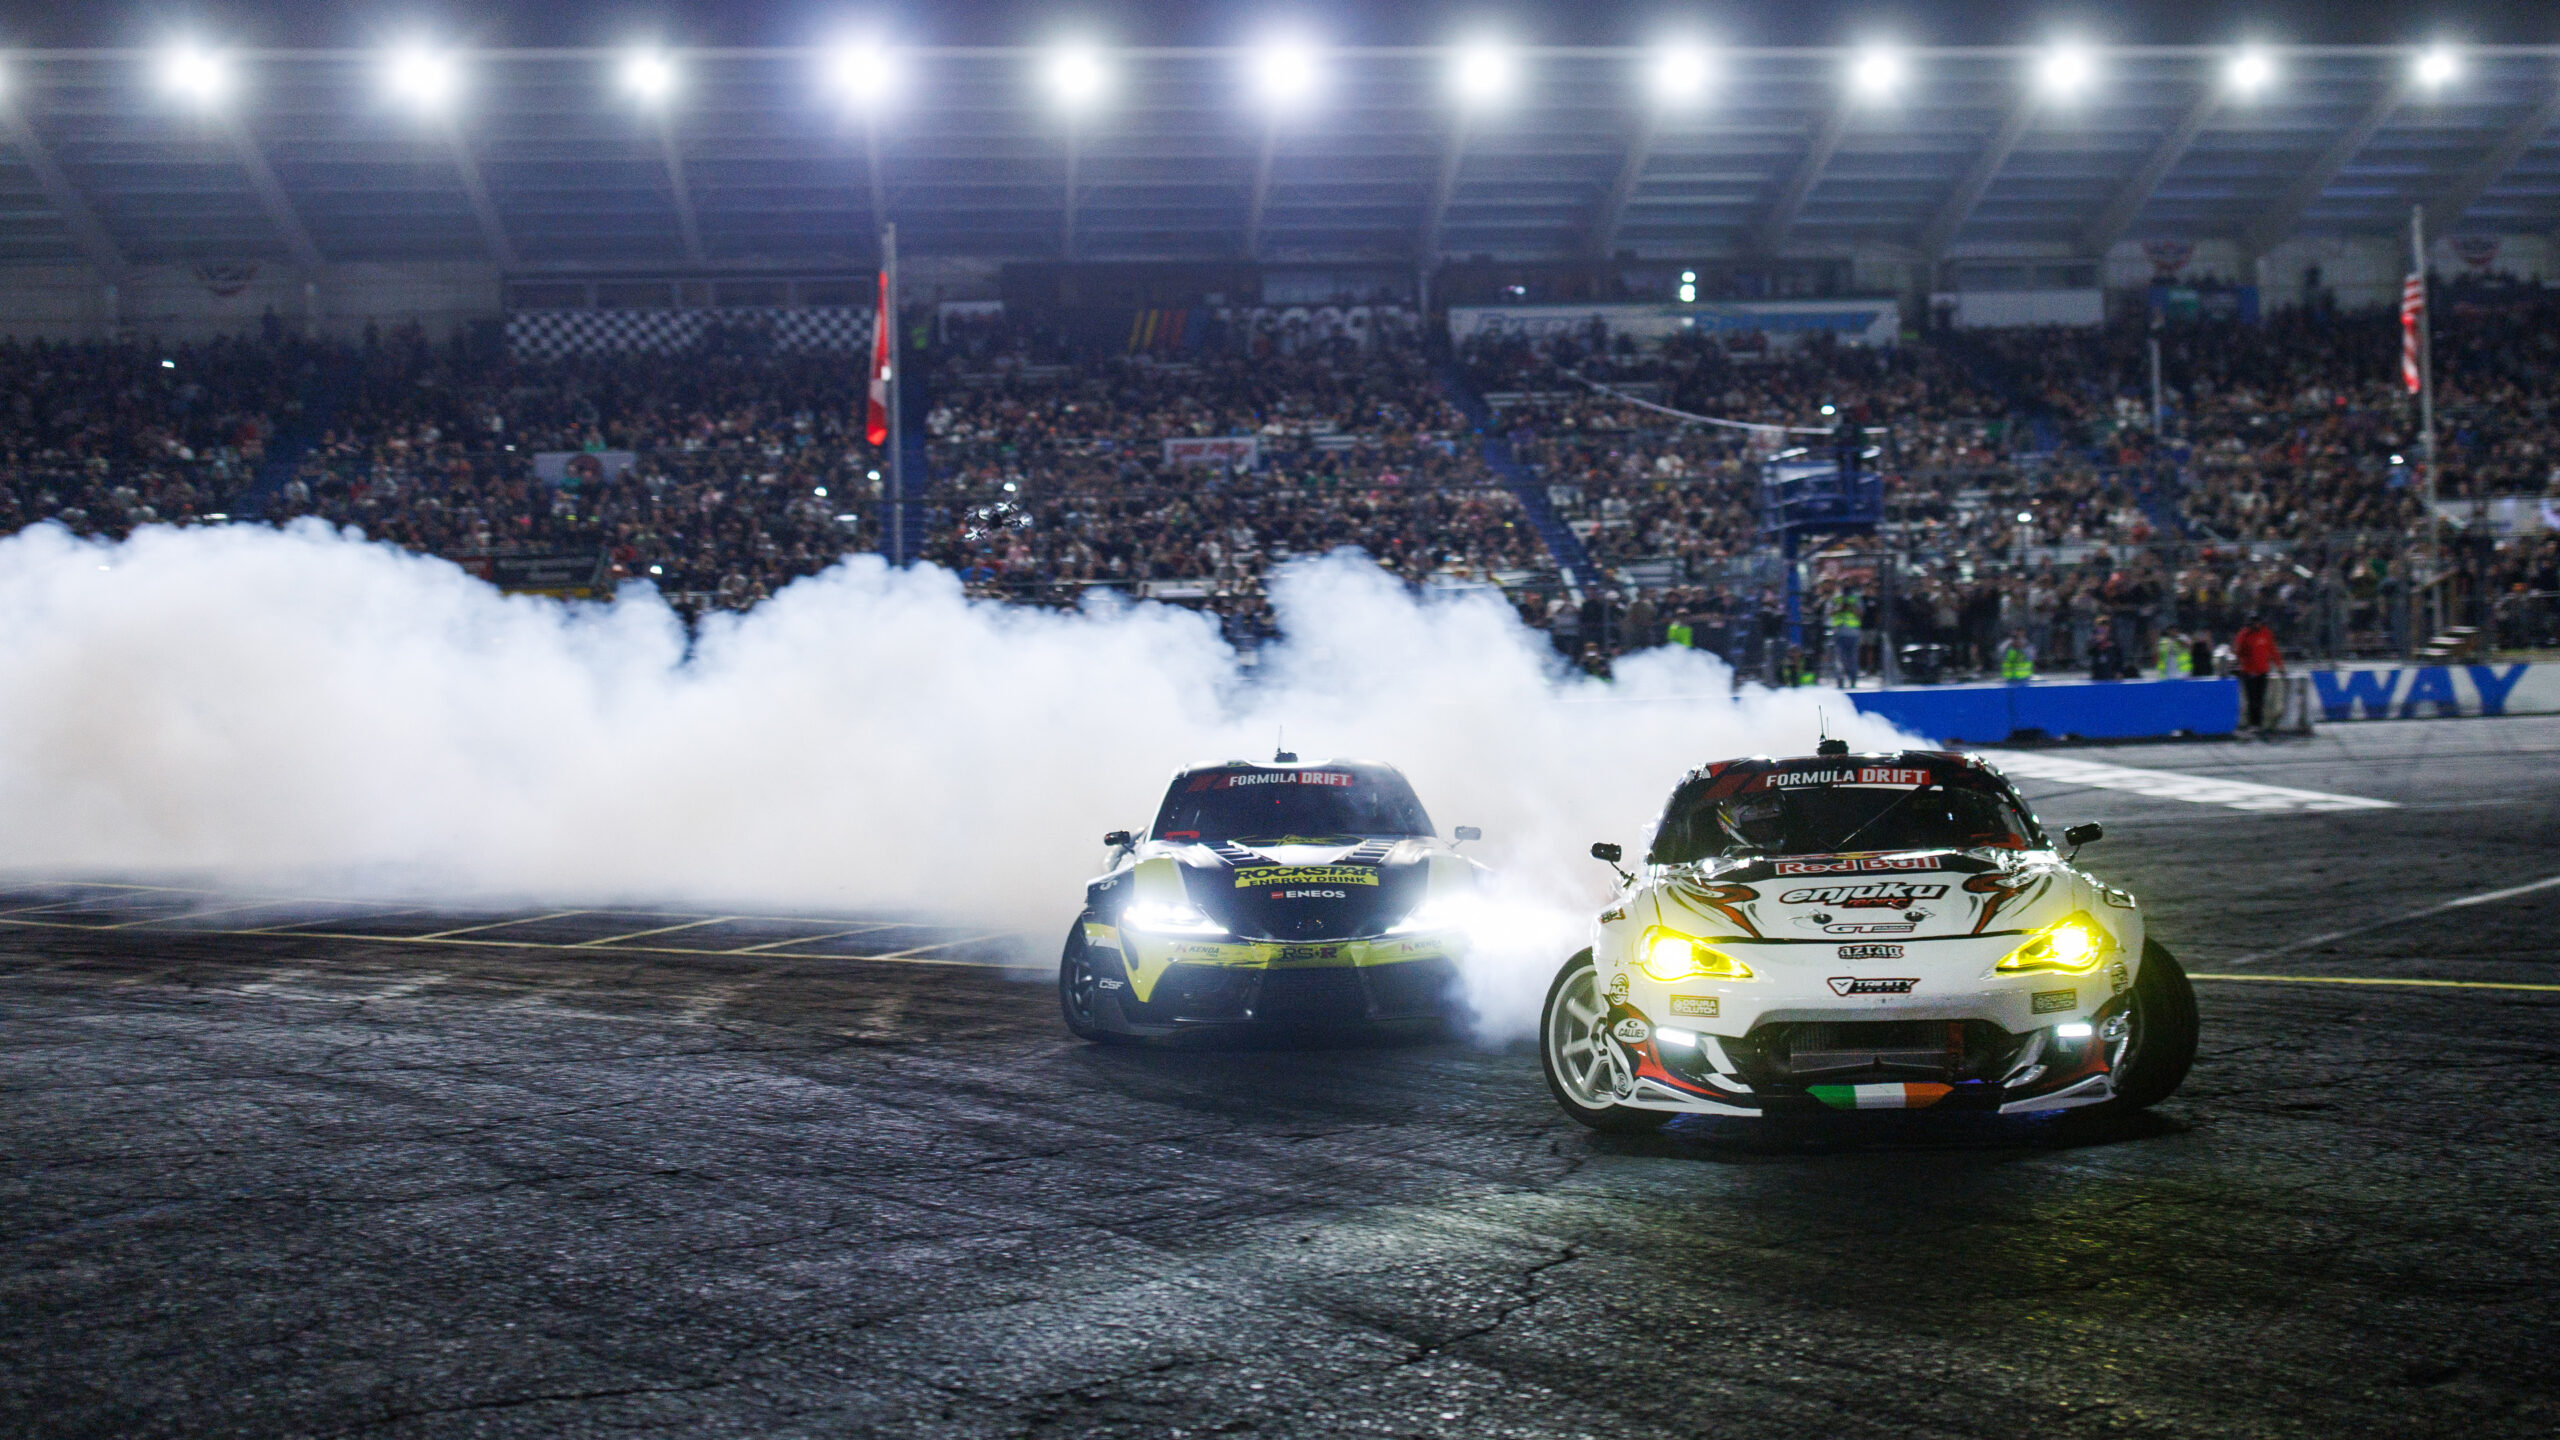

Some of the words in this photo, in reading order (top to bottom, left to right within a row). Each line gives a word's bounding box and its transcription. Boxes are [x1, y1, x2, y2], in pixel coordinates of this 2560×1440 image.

[2310, 663, 2530, 720] WAY
[1229, 773, 1297, 786] FORMULA
[1302, 772, 1350, 785] DRIFT
[1766, 769, 1855, 788] FORMULA
[1862, 769, 1927, 784] DRIFT
[1777, 860, 1857, 875] Red
[1861, 857, 1941, 871] Bull
[1235, 866, 1378, 880] ROCKSTAR
[1250, 877, 1312, 886] ENERGY
[1316, 876, 1367, 884] DRINK
[1286, 890, 1346, 899] ENEOS
[1780, 883, 1948, 904] enjuku
[1838, 945, 1903, 958] azrag
[1099, 979, 1124, 990] CSF
[1683, 1006, 1717, 1014] CLUTCH
[1618, 1027, 1646, 1038] CALLIES
